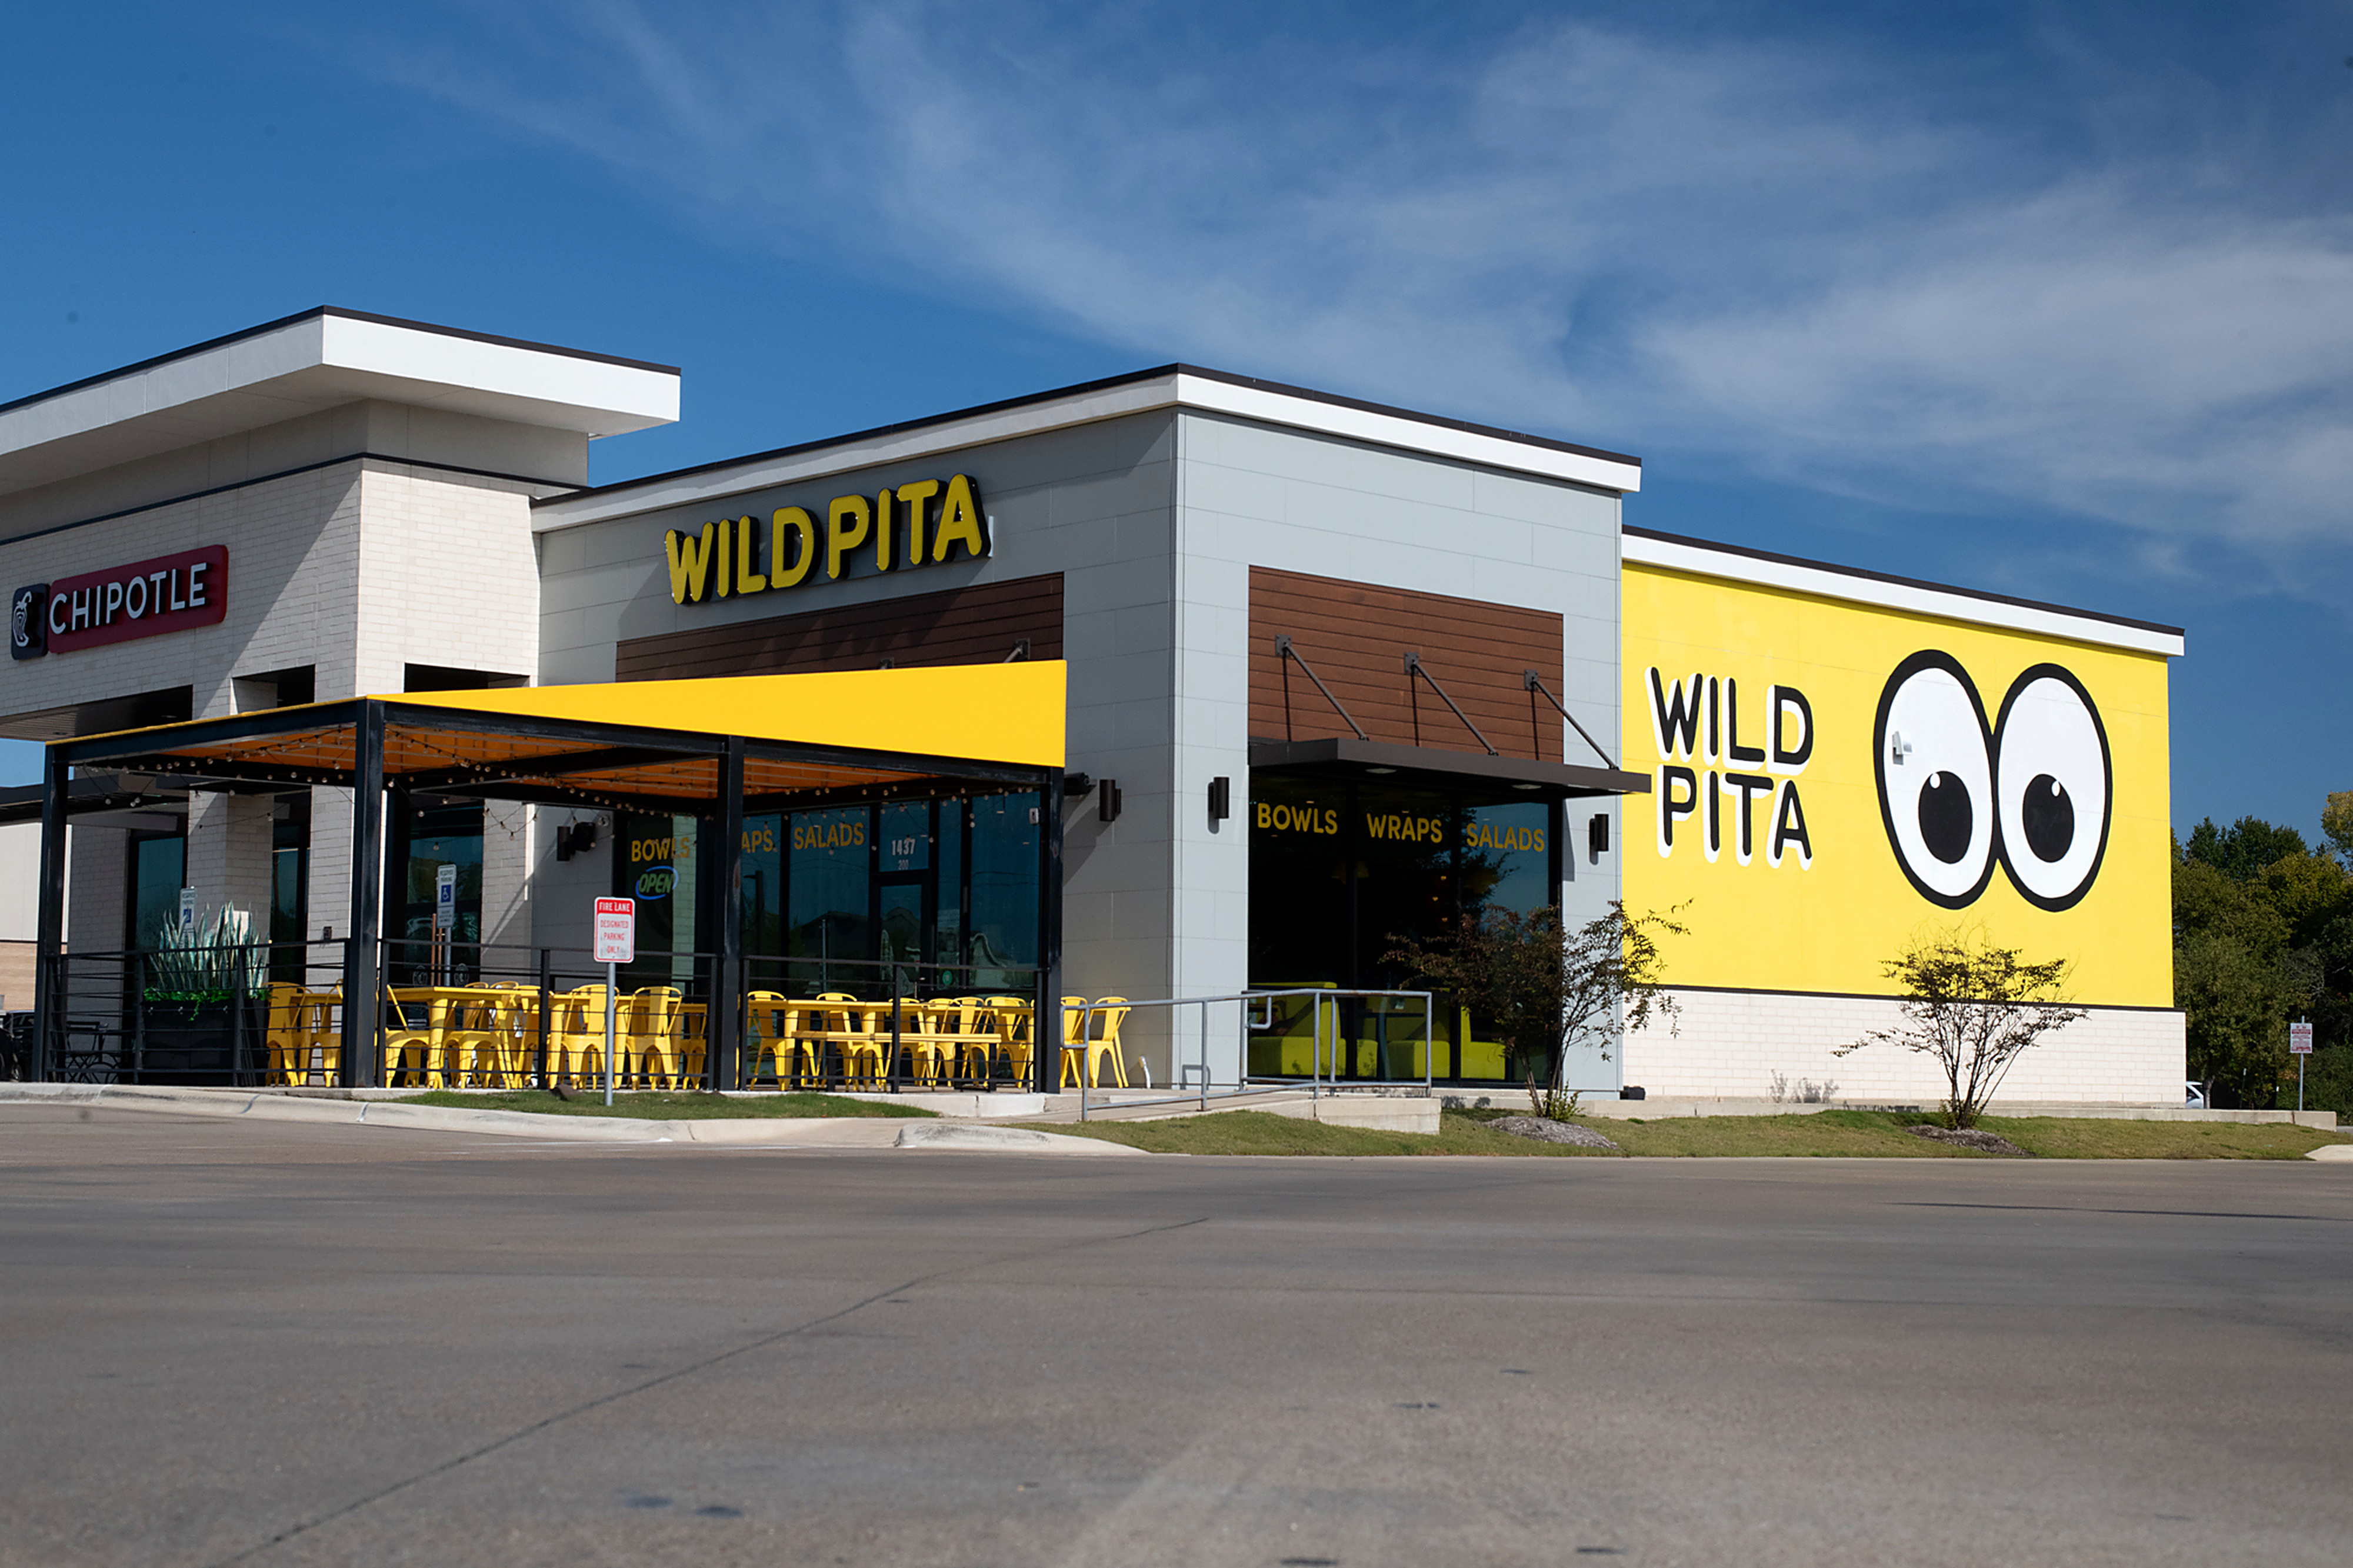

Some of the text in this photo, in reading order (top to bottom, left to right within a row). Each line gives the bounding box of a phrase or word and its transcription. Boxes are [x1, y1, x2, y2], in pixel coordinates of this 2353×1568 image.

[665, 473, 984, 605] WILD PITA
[49, 562, 206, 635] CHIPOTLE
[1645, 666, 1814, 776] WILD
[1257, 803, 1545, 852] BOWLS WRAPS SALADS
[1657, 763, 1813, 871] PITA
[631, 822, 864, 862] BOWLS APS SALADS
[892, 838, 915, 856] 1437
[639, 873, 674, 893] OPEN
[599, 902, 631, 913] FIRE LANE
[600, 920, 629, 929] DESIGNATED
[604, 932, 625, 942] PARKING
[606, 945, 620, 954] ONLY
